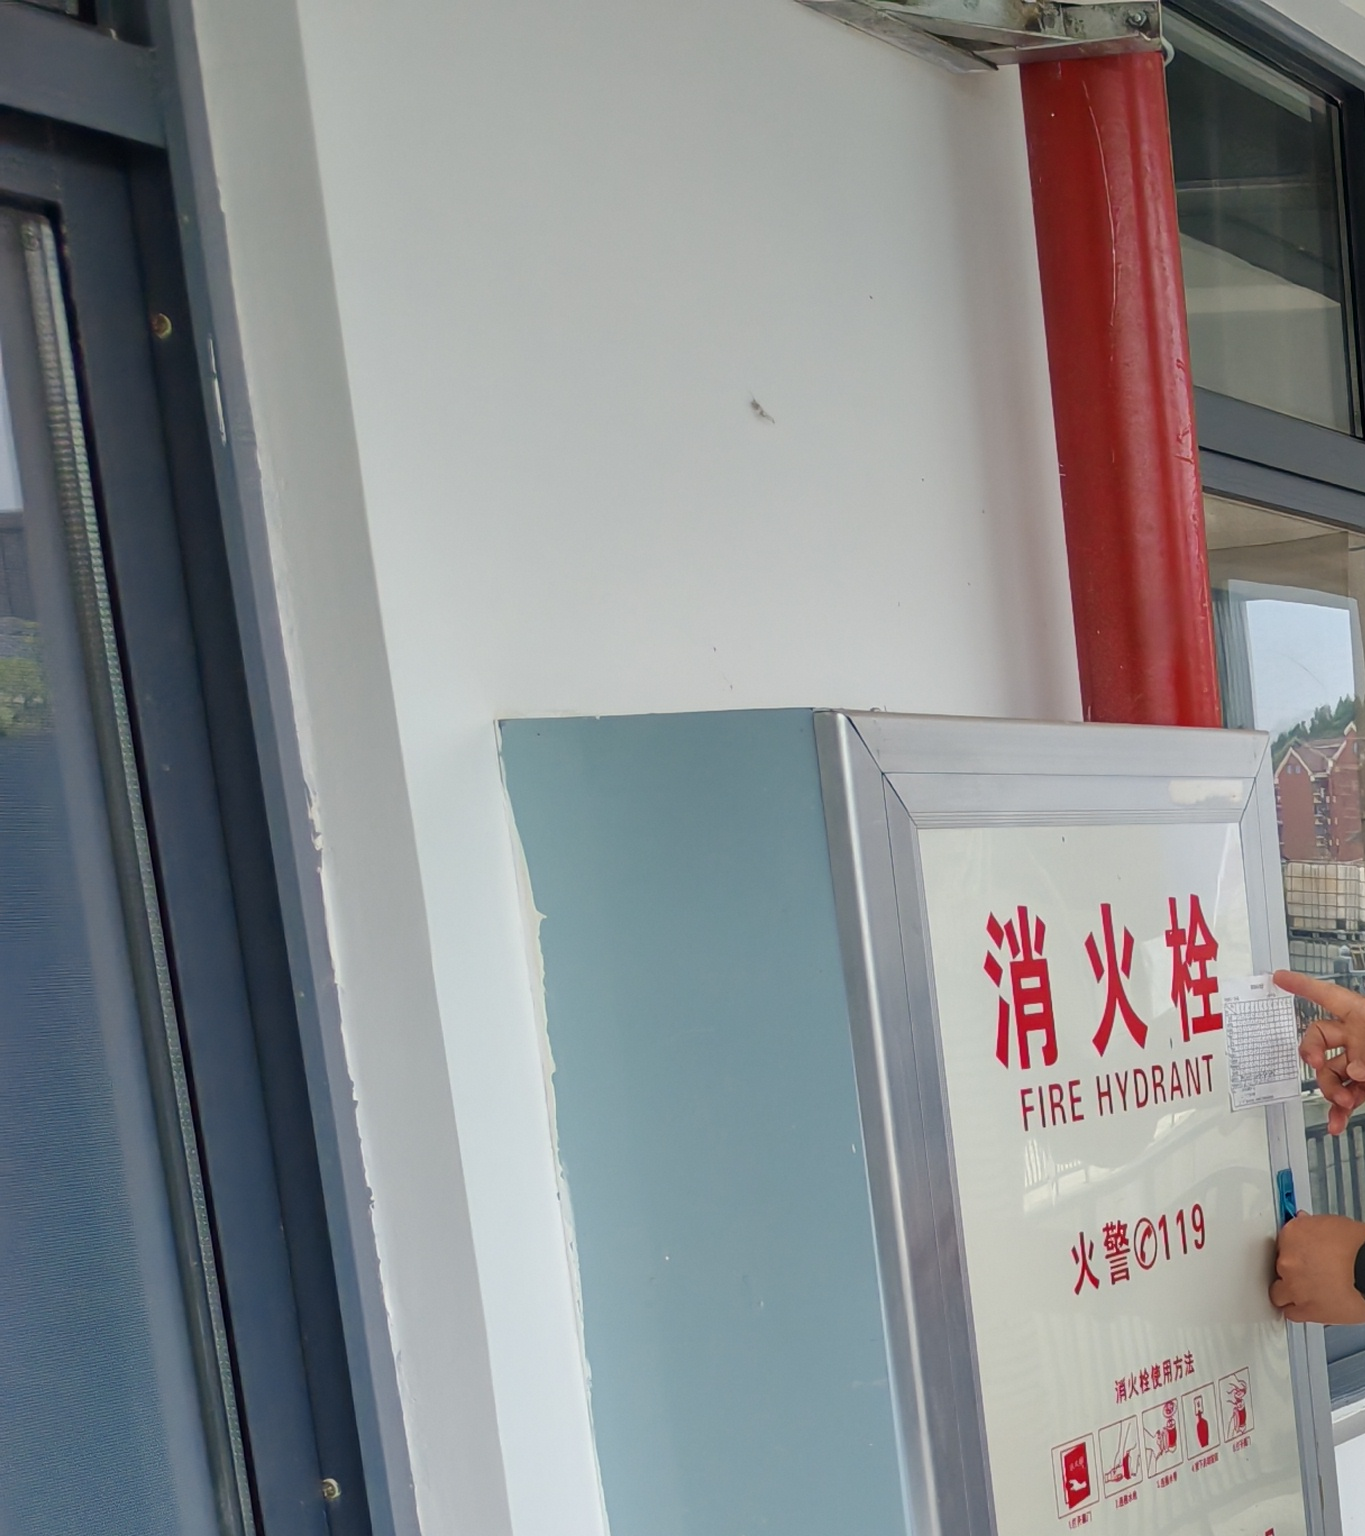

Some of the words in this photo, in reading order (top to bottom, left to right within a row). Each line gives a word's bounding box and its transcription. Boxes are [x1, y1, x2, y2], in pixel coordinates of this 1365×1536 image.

[983, 893, 1224, 1070] 消火栓
[1020, 1079, 1085, 1131] FIRE
[1096, 1054, 1215, 1117] HYDRANT
[1114, 1350, 1196, 1404] 消火栓使用方法
